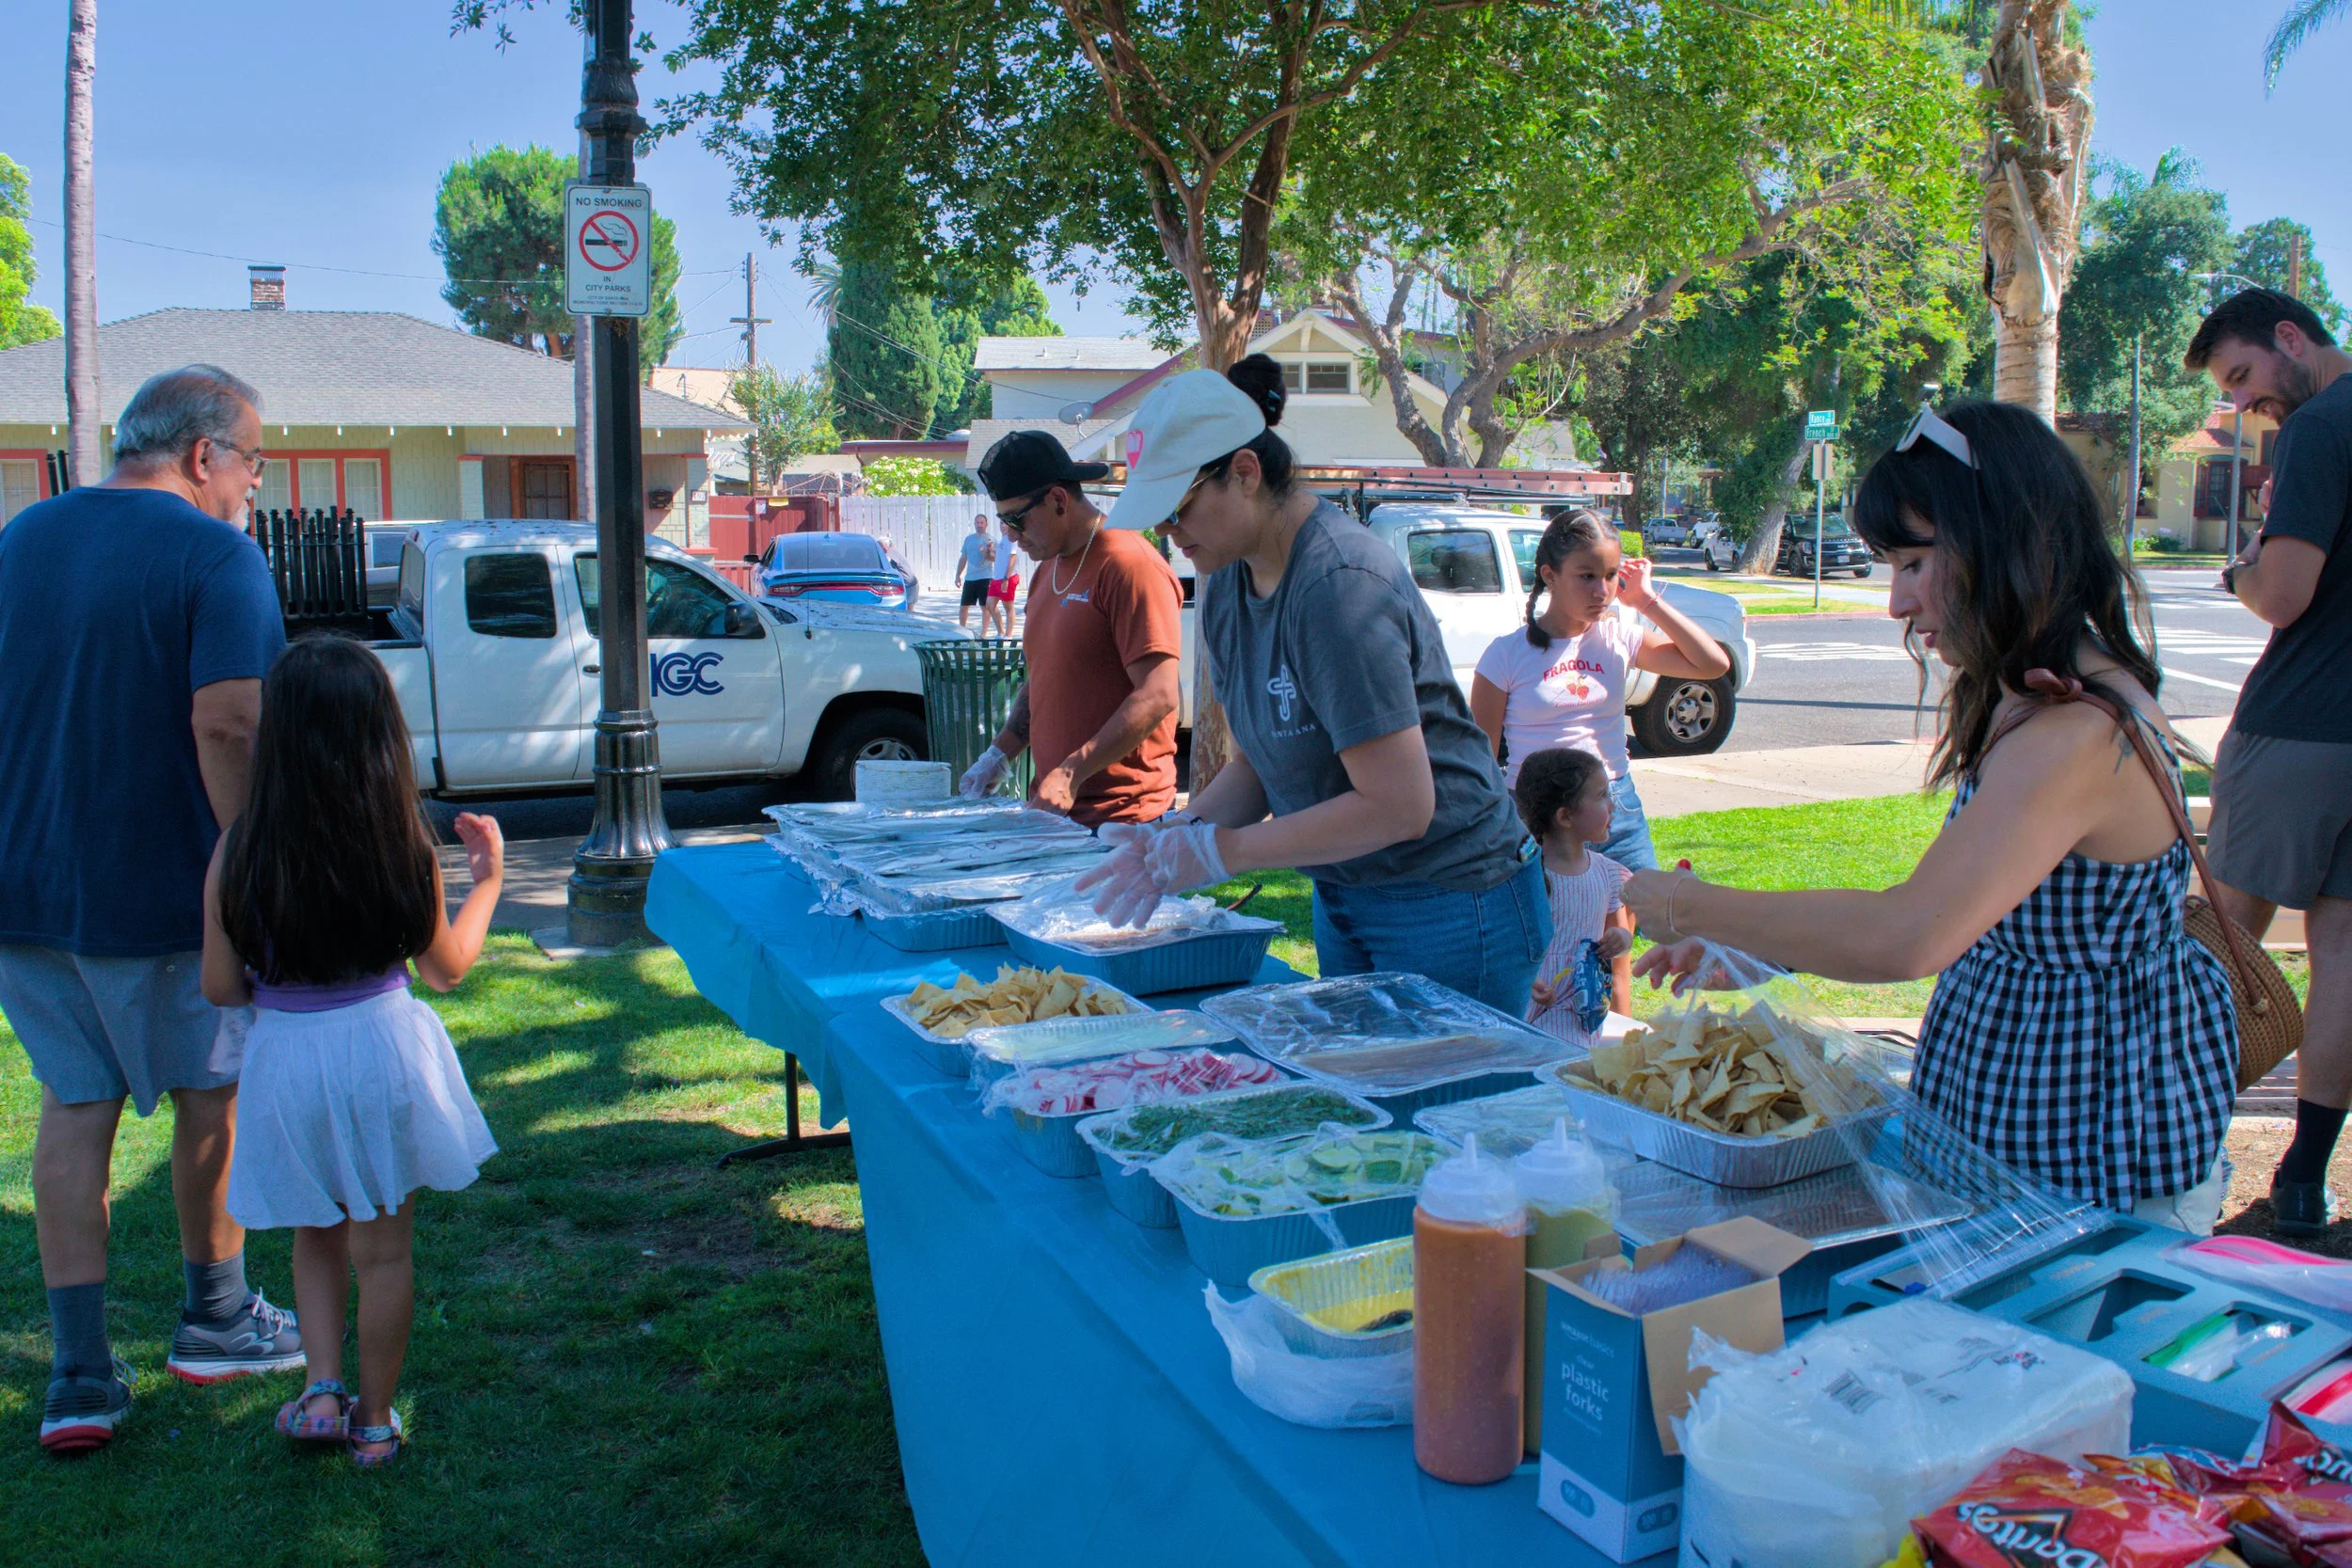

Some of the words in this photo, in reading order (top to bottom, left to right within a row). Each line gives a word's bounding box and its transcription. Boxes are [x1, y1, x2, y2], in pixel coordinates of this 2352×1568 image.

[576, 197, 592, 207] NO
[595, 198, 643, 208] SMOKING
[1806, 427, 1826, 437] French
[1543, 658, 1605, 682] FRAGOLA
[1295, 722, 1316, 736] ANA
[1561, 1362, 1610, 1403] plastic
[1565, 1383, 1603, 1421] forks
